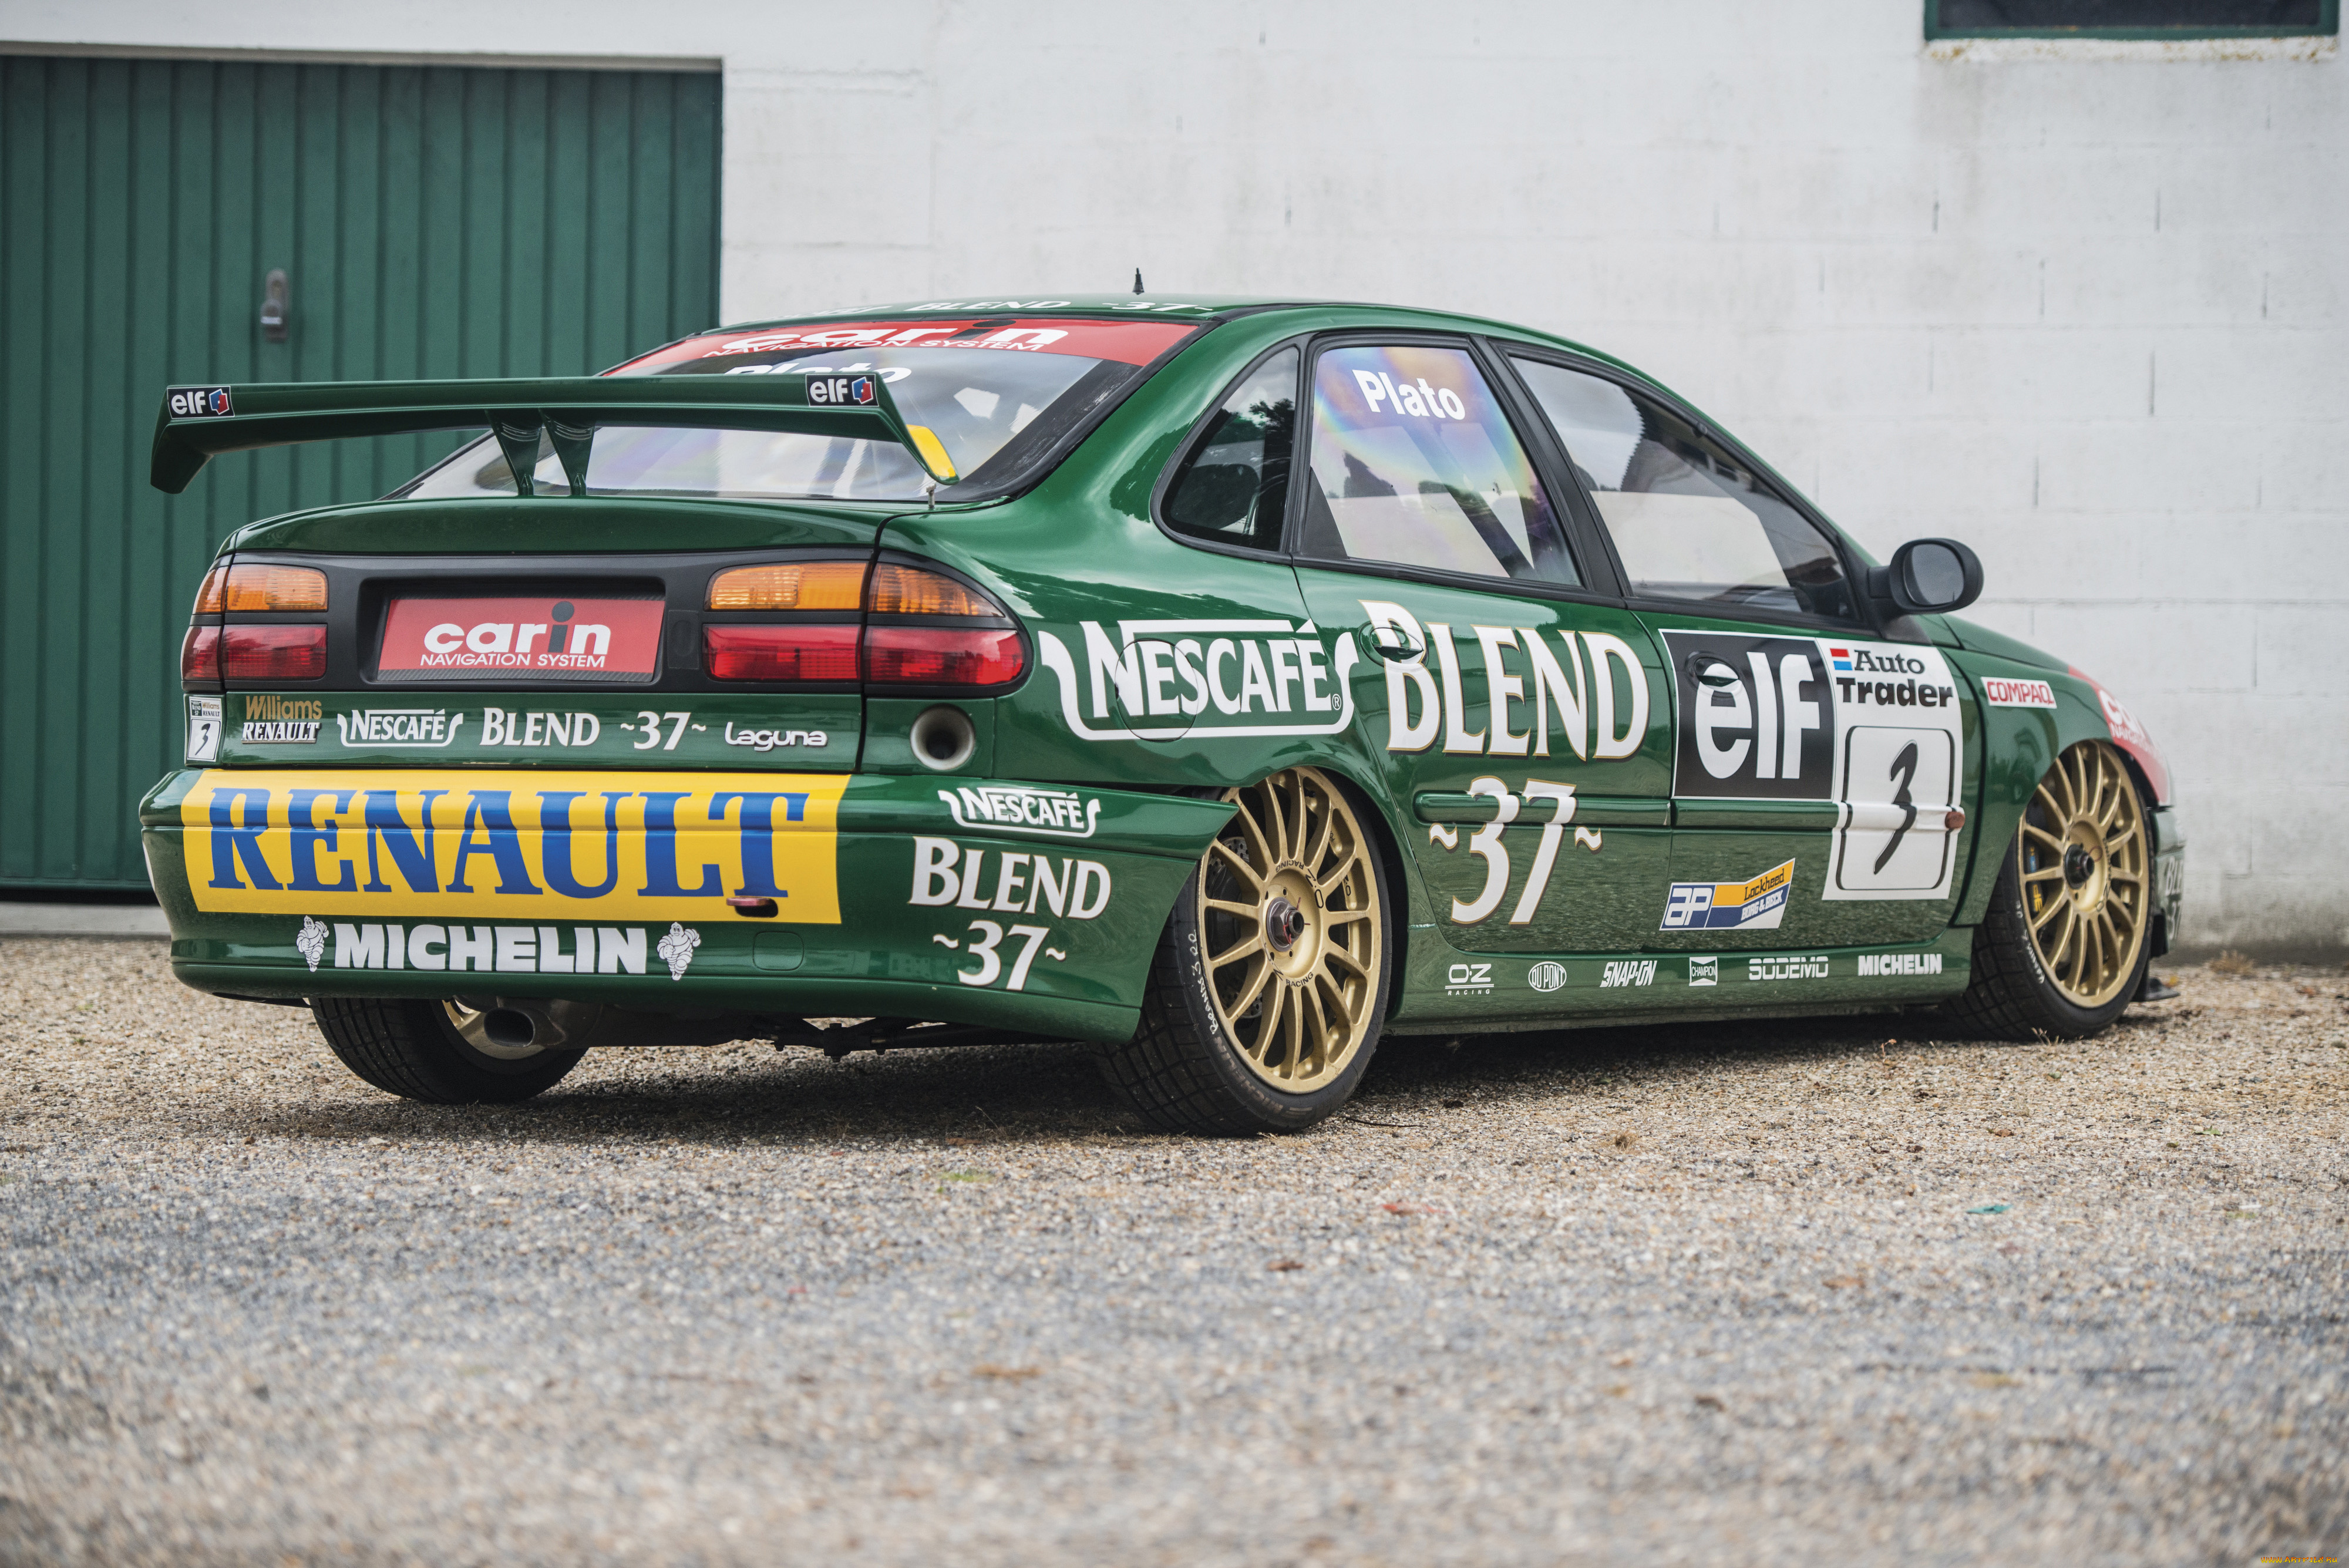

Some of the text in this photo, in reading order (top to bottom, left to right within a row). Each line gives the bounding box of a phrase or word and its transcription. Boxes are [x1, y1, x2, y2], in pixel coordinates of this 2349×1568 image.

[906, 300, 1071, 311] BLEND
[722, 318, 1069, 350] carin
[703, 339, 1044, 357] NAVIGATION SYSTEM
[171, 391, 206, 415] elf
[810, 378, 848, 403] elf
[1352, 369, 1466, 420] Plato
[424, 600, 611, 654] carin
[420, 652, 606, 668] NAVIGATION SYSTEM
[1854, 649, 1926, 674] Auto
[1358, 600, 1650, 762] BLEND
[1836, 677, 1954, 708] Trader
[1987, 681, 2055, 704] COMPAQ
[202, 702, 220, 710] Williams
[245, 695, 322, 721] Williams
[1695, 651, 1820, 779] elf
[241, 722, 322, 743] RENAULT
[351, 708, 446, 741] NESCAFÉ
[479, 707, 601, 746] BLEND
[957, 787, 1085, 829] NESCAFÉ
[1873, 739, 1918, 875] 3
[207, 786, 810, 899] RENAULT
[907, 836, 1111, 920] BLEND
[1275, 859, 1304, 873] RACING
[1744, 867, 1785, 901] Lockheed
[1741, 901, 1759, 921] BORG
[1765, 889, 1784, 911] BECK
[334, 923, 647, 974] MICHELIN
[1691, 965, 1717, 977] CHAMPION
[1749, 955, 1829, 981] SODEMO
[1857, 953, 1943, 977] MICHELIN
[1285, 971, 1314, 988] RACING
